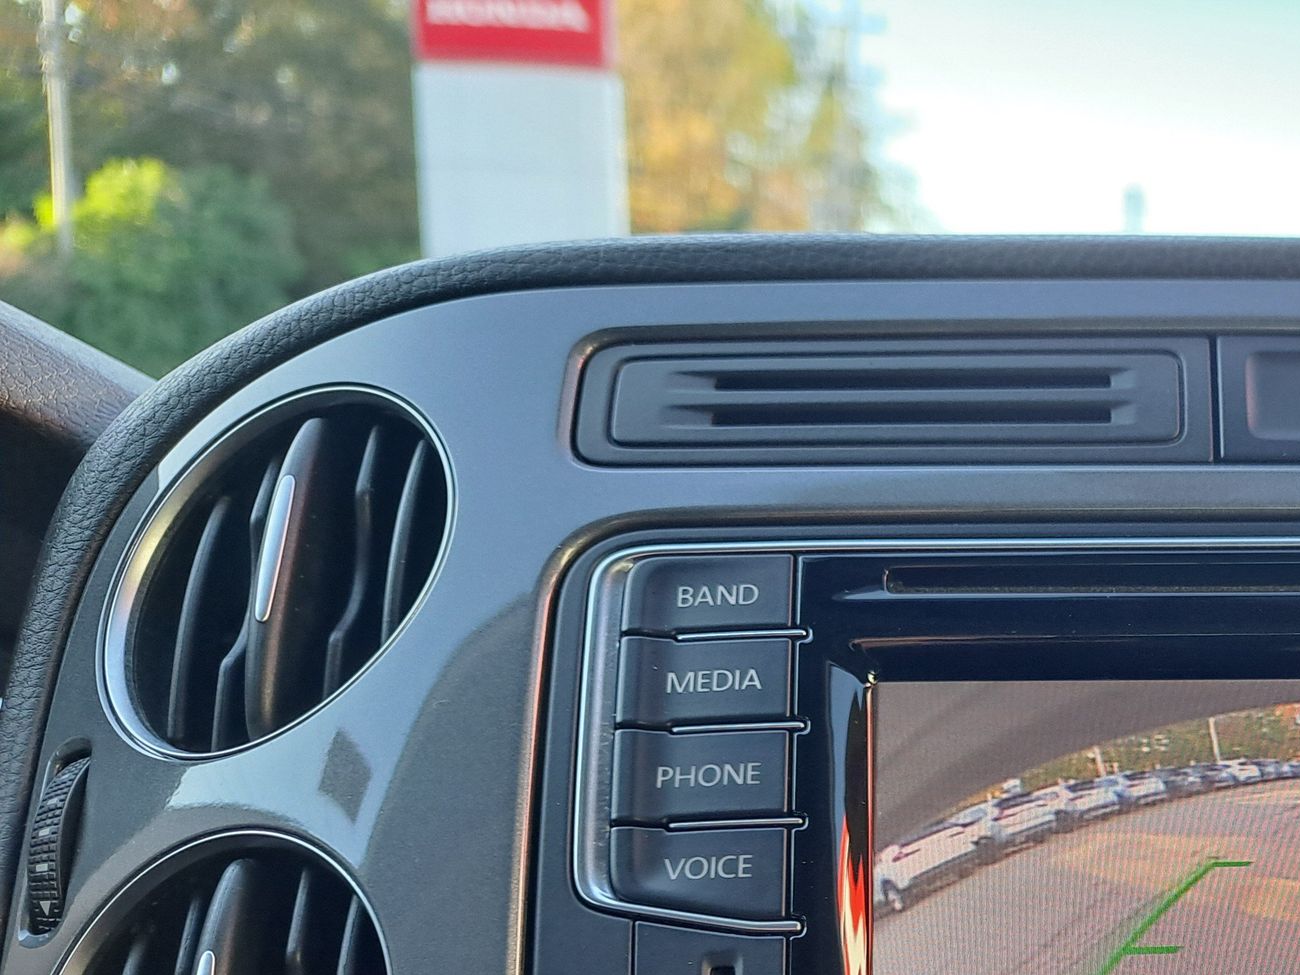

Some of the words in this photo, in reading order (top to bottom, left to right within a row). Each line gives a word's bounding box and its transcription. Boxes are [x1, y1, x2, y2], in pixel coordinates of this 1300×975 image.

[676, 584, 759, 608] BAND
[666, 669, 763, 694] MEDIA
[656, 763, 762, 789] PHONE
[664, 855, 753, 880] VOICE
